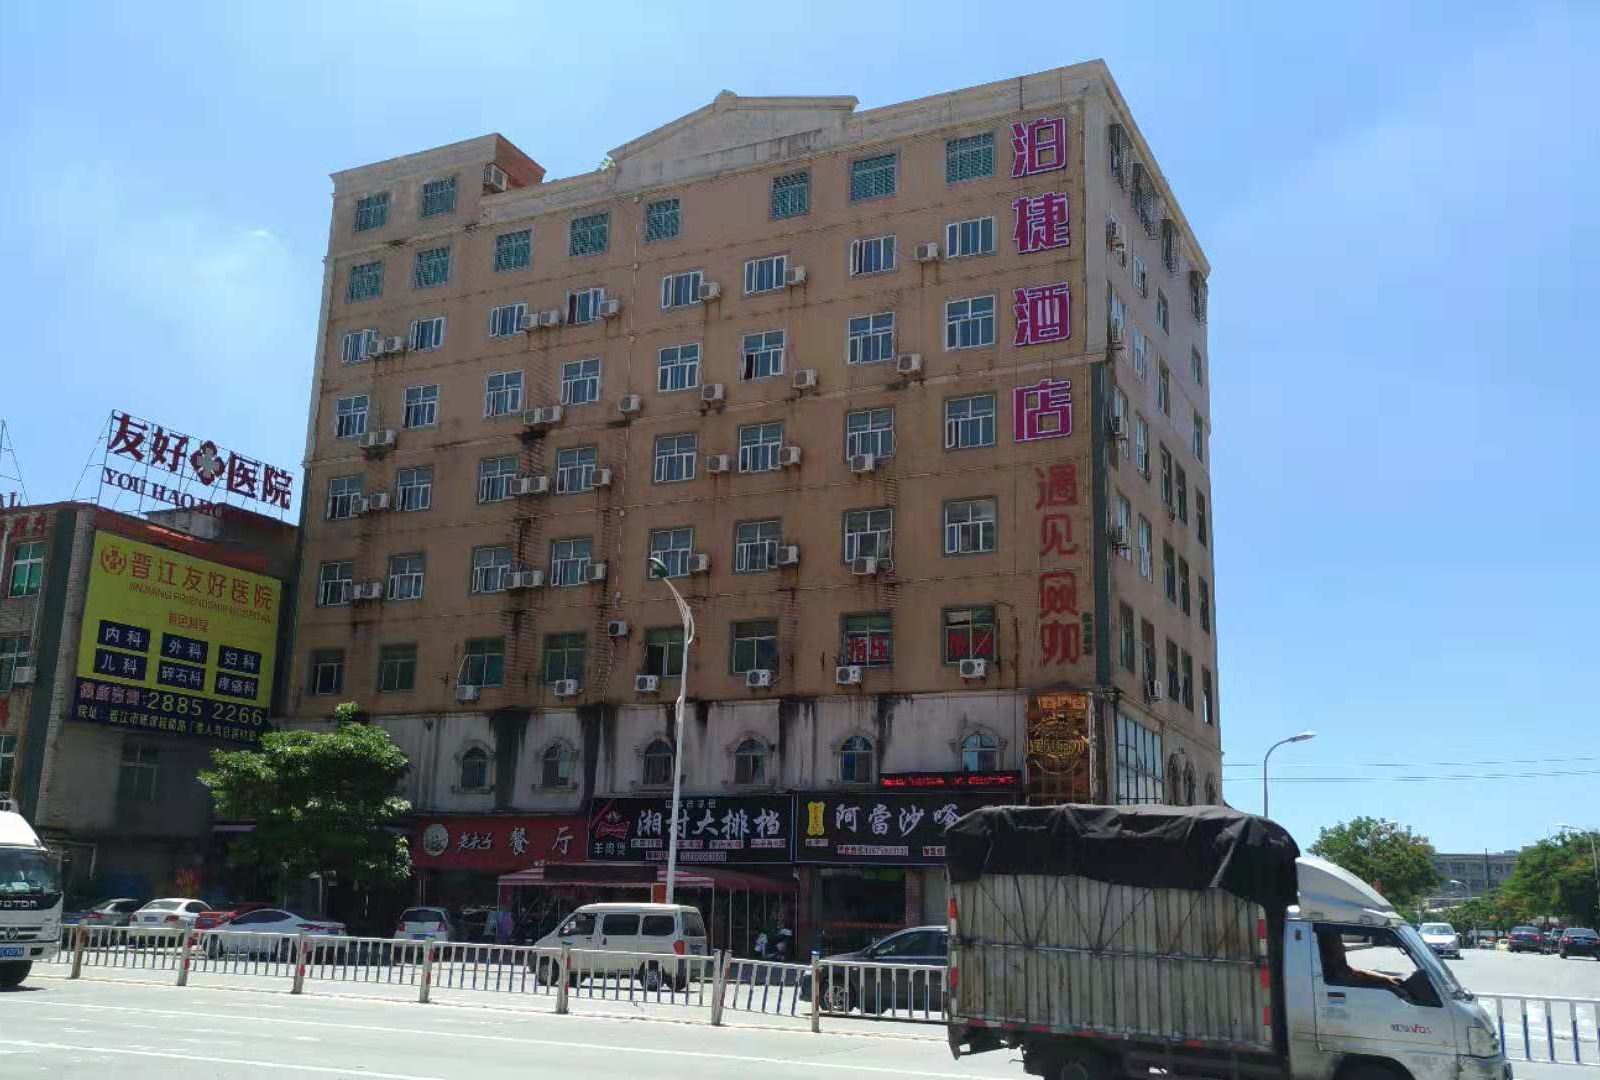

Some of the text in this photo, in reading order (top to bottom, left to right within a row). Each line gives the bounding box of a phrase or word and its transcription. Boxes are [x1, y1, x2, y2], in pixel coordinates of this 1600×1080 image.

[104, 467, 147, 494] YOU
[152, 482, 195, 509] HAO
[131, 552, 273, 610] 晋江友好医院
[105, 626, 143, 646] 内科
[169, 639, 202, 661] 外科
[224, 651, 256, 671] 妇科
[101, 655, 138, 675] 儿科
[147, 692, 202, 716] 2885
[212, 703, 263, 726] 2266
[508, 826, 574, 857] 餐厅
